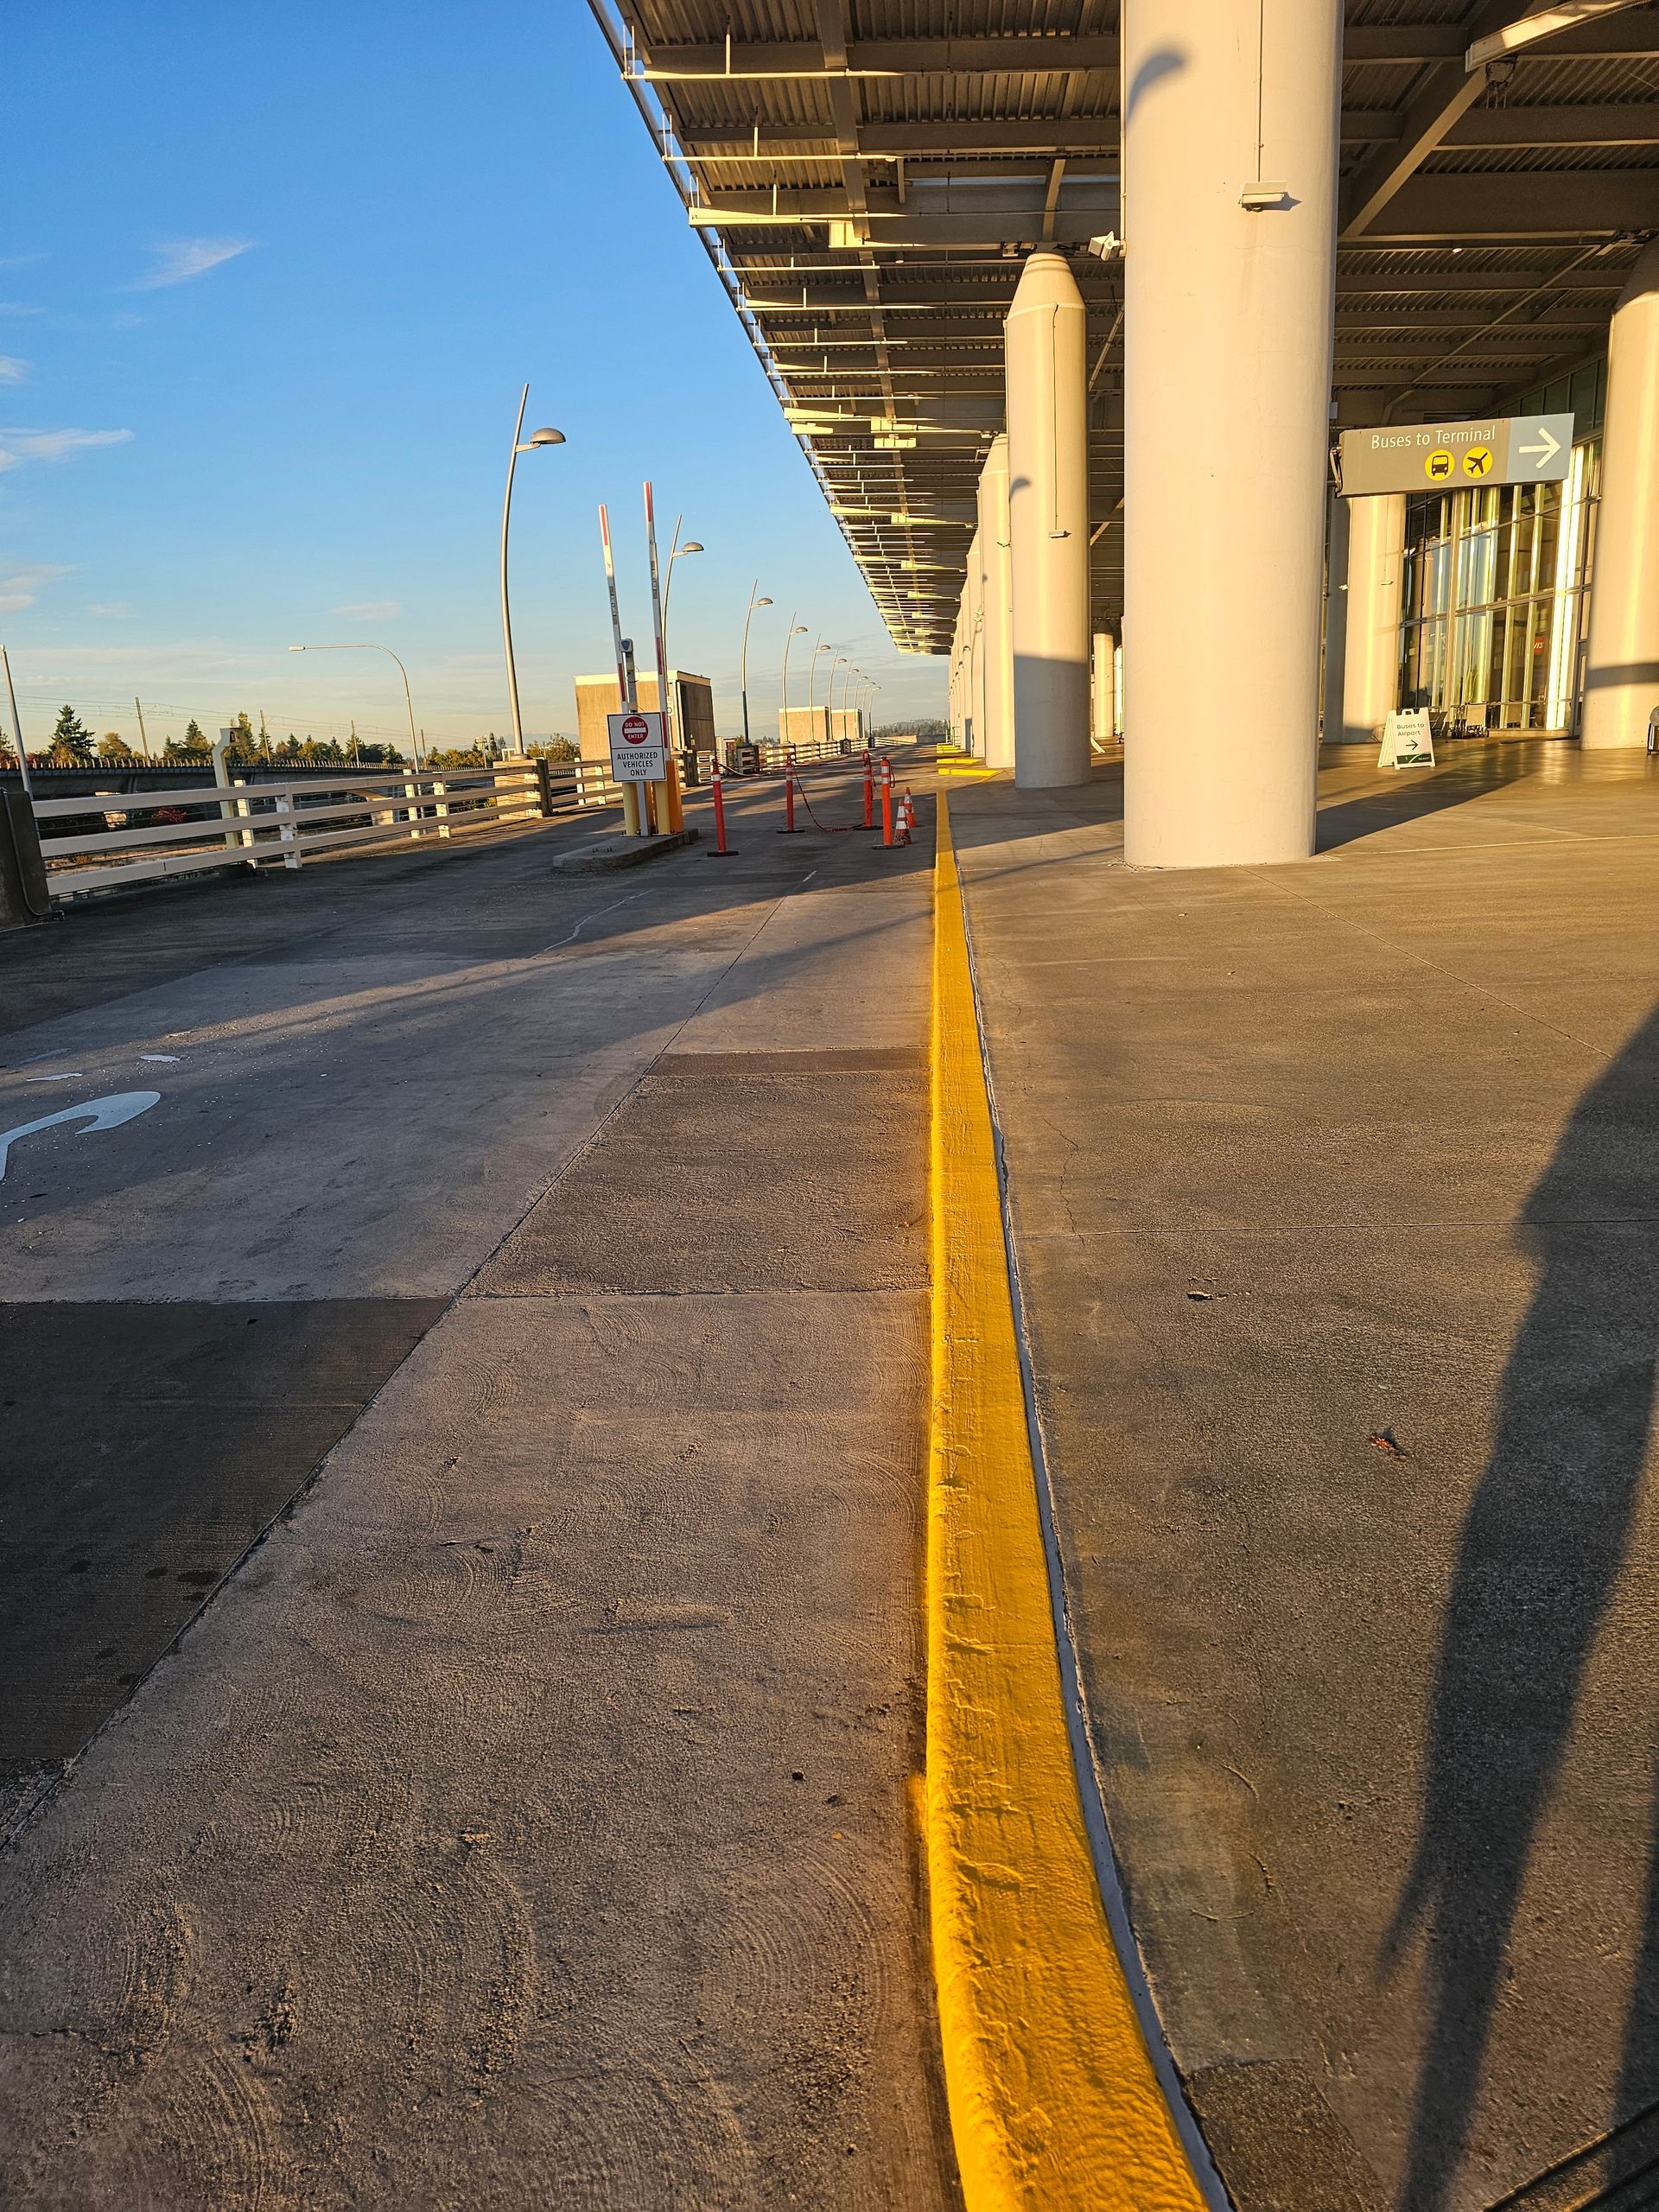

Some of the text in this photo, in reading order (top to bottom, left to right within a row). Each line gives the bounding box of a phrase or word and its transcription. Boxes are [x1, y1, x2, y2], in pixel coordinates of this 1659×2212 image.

[1371, 426, 1495, 448] Buses to Terminal
[617, 752, 658, 760] AUTHORIZED
[630, 768, 647, 777] ONLY
